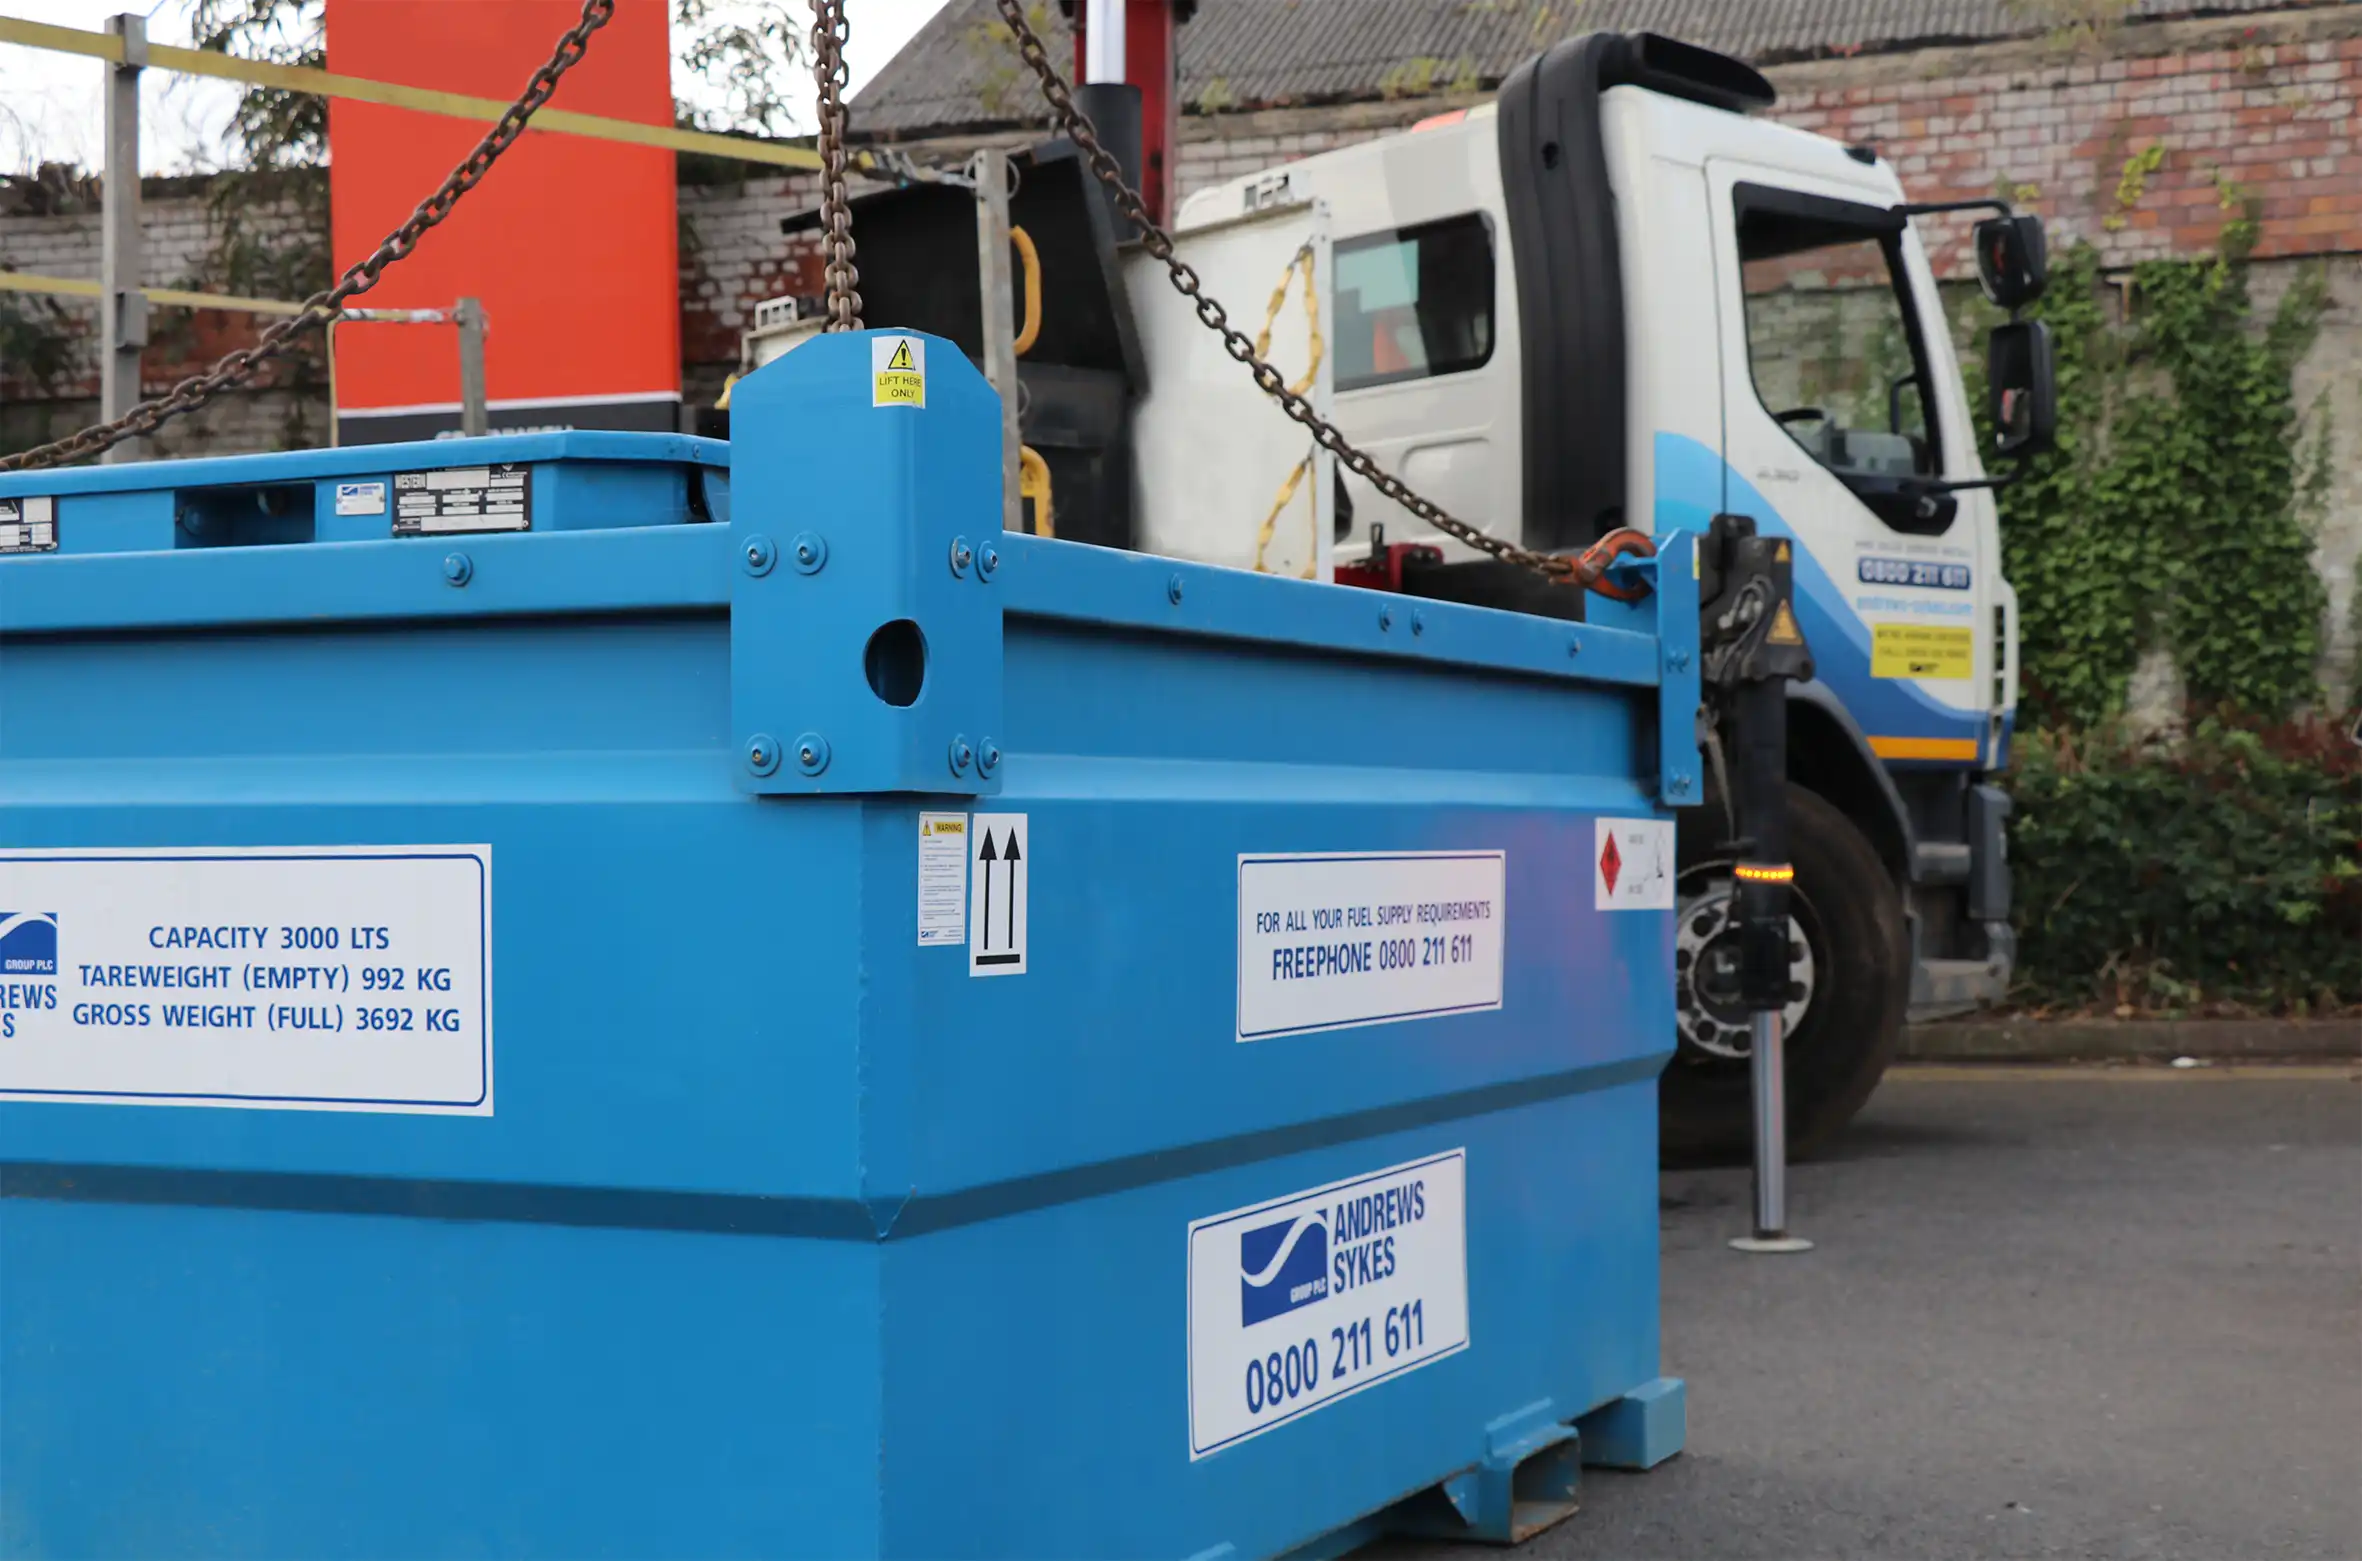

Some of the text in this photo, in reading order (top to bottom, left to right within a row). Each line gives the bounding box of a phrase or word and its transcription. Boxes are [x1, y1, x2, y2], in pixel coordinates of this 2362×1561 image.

[879, 376, 921, 387] LIFT HERE
[891, 388, 915, 398] ONLY
[936, 824, 962, 832] WARNING
[1257, 900, 1491, 933] FOR ALL YOUR FUEL SUPPLY REQUIREMENTS
[149, 926, 390, 950] CAPACITY 3000 LTS
[5, 959, 54, 970] GROUP PLC
[1272, 934, 1473, 981] FREEPHONE 0800 211 611
[78, 963, 452, 993] TAREWEIGHT (EMPTY) 992 KG
[72, 1002, 460, 1033] GROSS WEIGHT (FULL) 3692 KG
[1333, 1179, 1425, 1246] ANDREWS
[1333, 1235, 1396, 1294] SYKES
[1246, 1298, 1425, 1414] 0800 211 611
